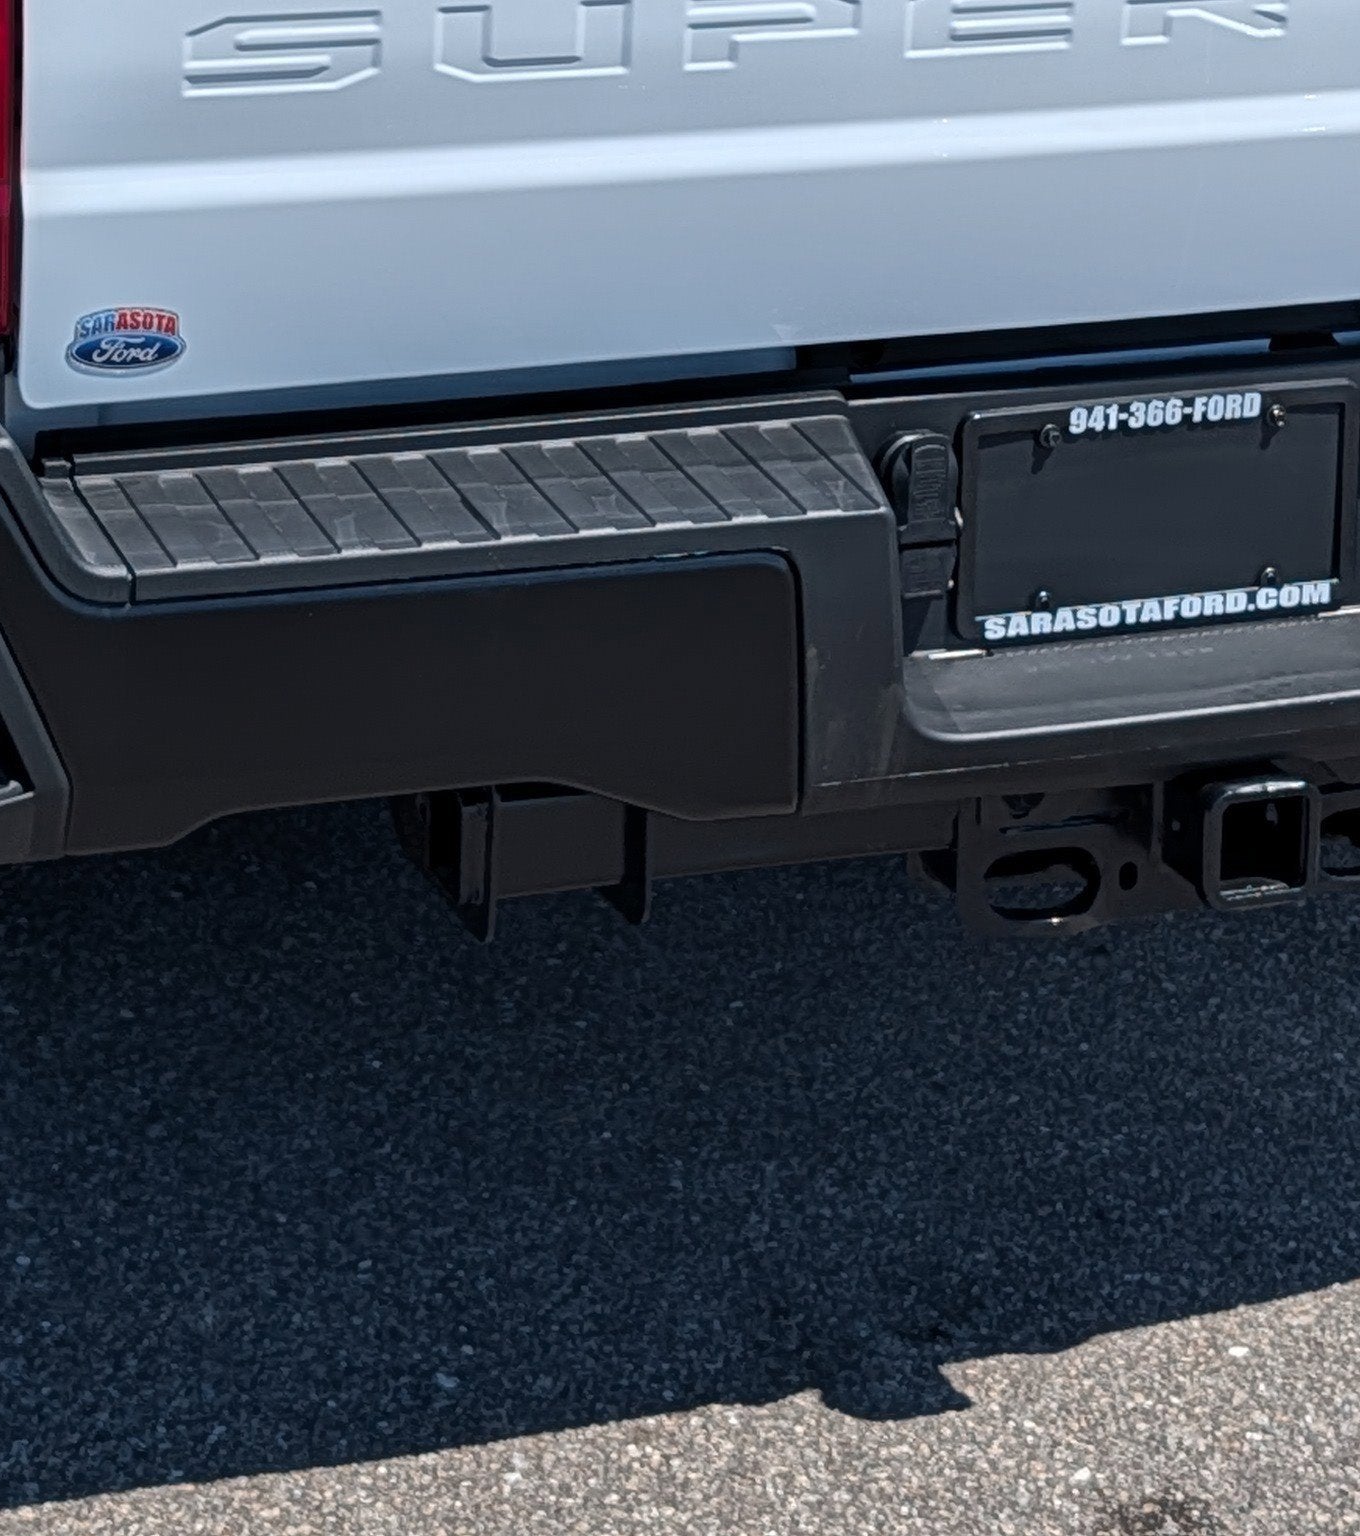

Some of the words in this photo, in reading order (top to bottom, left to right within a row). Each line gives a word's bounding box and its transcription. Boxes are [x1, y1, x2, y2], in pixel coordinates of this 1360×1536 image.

[79, 310, 177, 338] SARASOTA
[92, 336, 158, 363] Ford
[1068, 391, 1263, 436] 941-366-FORD
[983, 581, 1332, 642] SARASOTAFORD.COM
